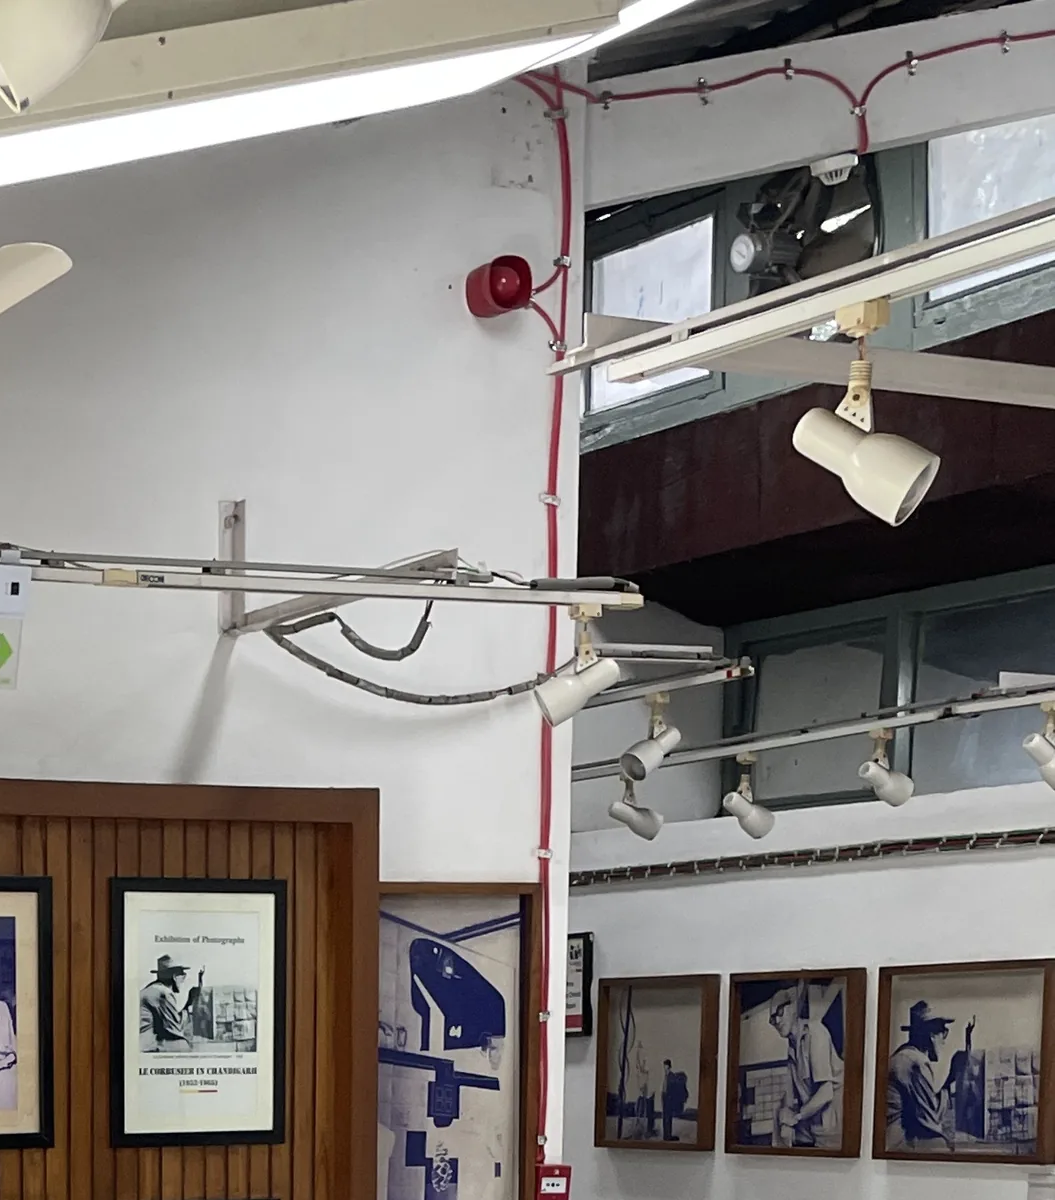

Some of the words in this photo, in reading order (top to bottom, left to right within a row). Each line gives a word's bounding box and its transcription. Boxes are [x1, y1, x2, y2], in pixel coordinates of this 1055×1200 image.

[155, 935, 190, 943] Exhibition
[202, 936, 244, 945] Photographs
[150, 1067, 194, 1075] CORBUSIER
[196, 1067, 205, 1075] IN
[207, 1067, 257, 1075] CHANDIGARH
